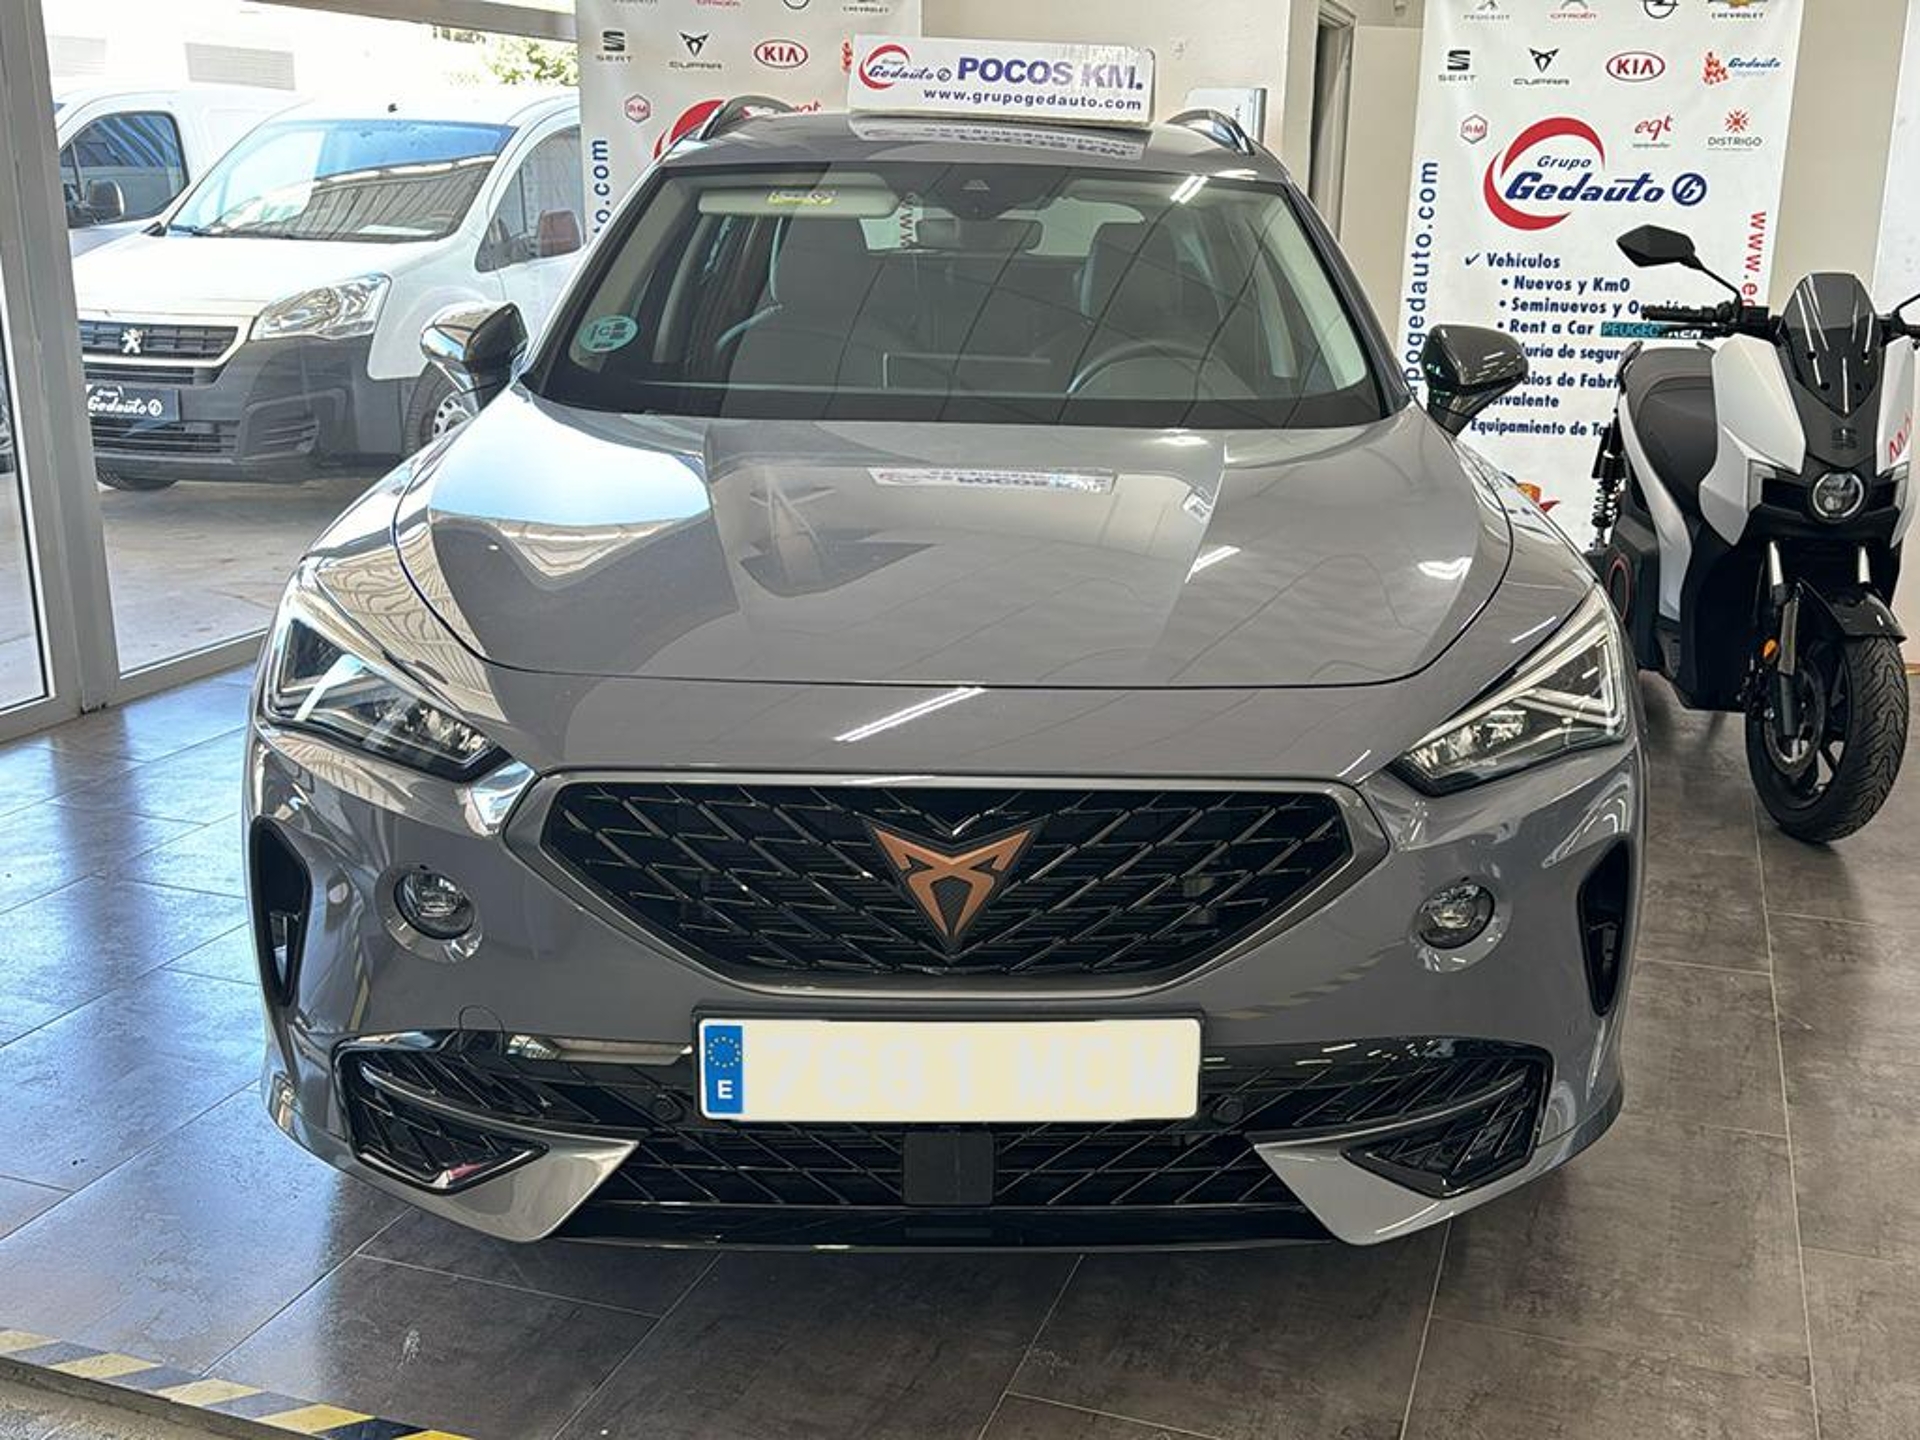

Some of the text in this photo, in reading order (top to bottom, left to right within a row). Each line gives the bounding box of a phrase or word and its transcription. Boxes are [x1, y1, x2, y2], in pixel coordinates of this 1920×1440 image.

[764, 46, 799, 62] KIA
[868, 65, 933, 81] Gedauto
[958, 57, 1073, 86] POCOS
[1616, 59, 1654, 75] KIA
[1438, 74, 1477, 82] SEAT
[923, 88, 1142, 111] www.grupogedauto.com
[1708, 136, 1763, 147] DISTRIGO
[1537, 155, 1592, 171] Grupo
[1505, 171, 1665, 203] Gedauto
[1514, 275, 1572, 291] Nuevos
[1578, 281, 1588, 296] y
[1511, 297, 1607, 314] Seminuevos
[1613, 303, 1623, 318] y
[1509, 319, 1595, 335] Rent a Car
[1557, 344, 1580, 359] de
[1580, 348, 1621, 364] segur
[1557, 372, 1576, 387] de
[87, 395, 148, 414] Gedauto
[1470, 418, 1566, 436] Equipamiento
[1569, 420, 1587, 436] de
[717, 1079, 734, 1100] E
